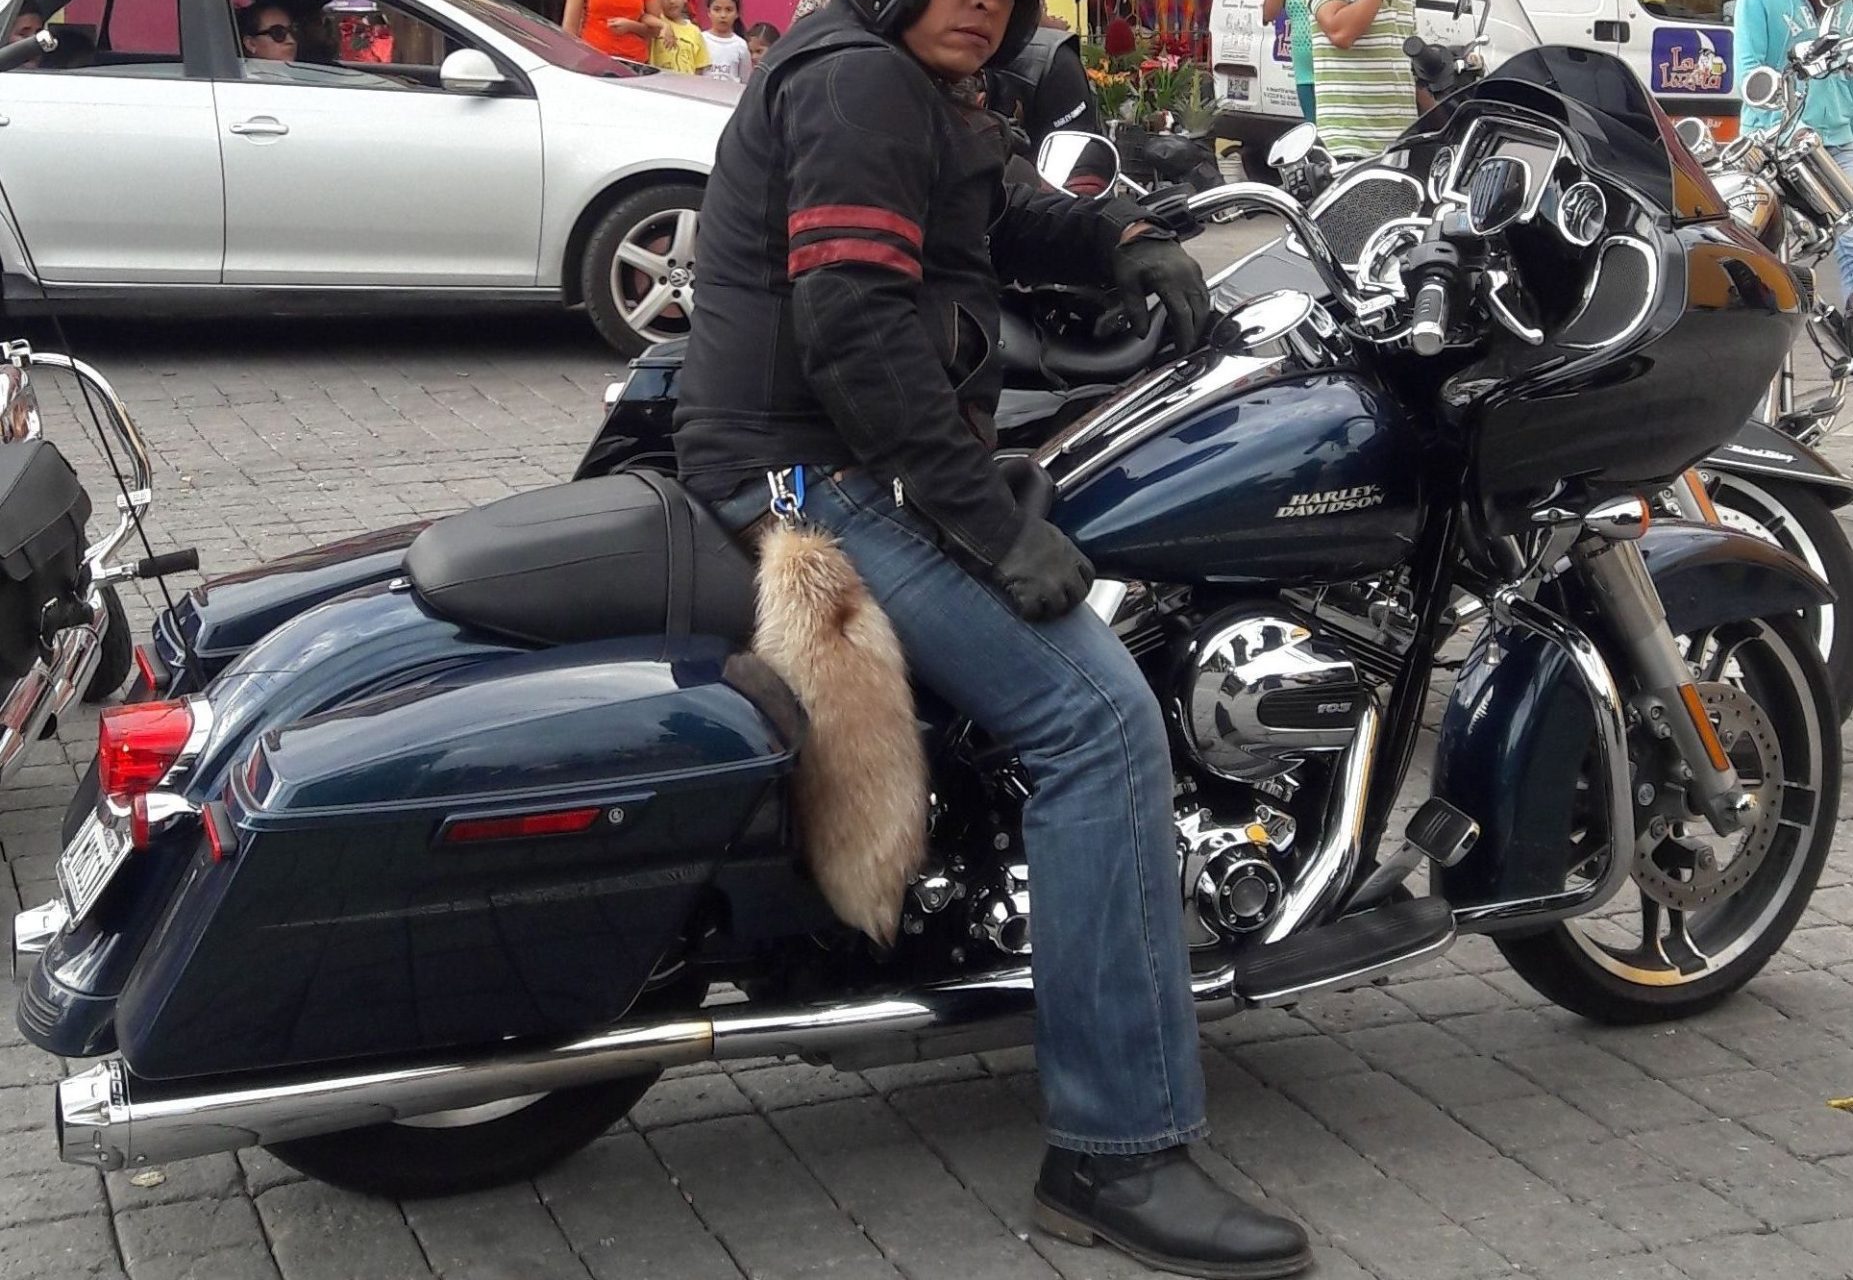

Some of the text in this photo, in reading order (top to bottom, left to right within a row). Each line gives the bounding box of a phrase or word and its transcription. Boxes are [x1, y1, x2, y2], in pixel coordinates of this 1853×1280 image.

[1671, 46, 1695, 71] La
[1275, 493, 1386, 518] DAVIDSON
[1289, 484, 1381, 506] HARLEY-
